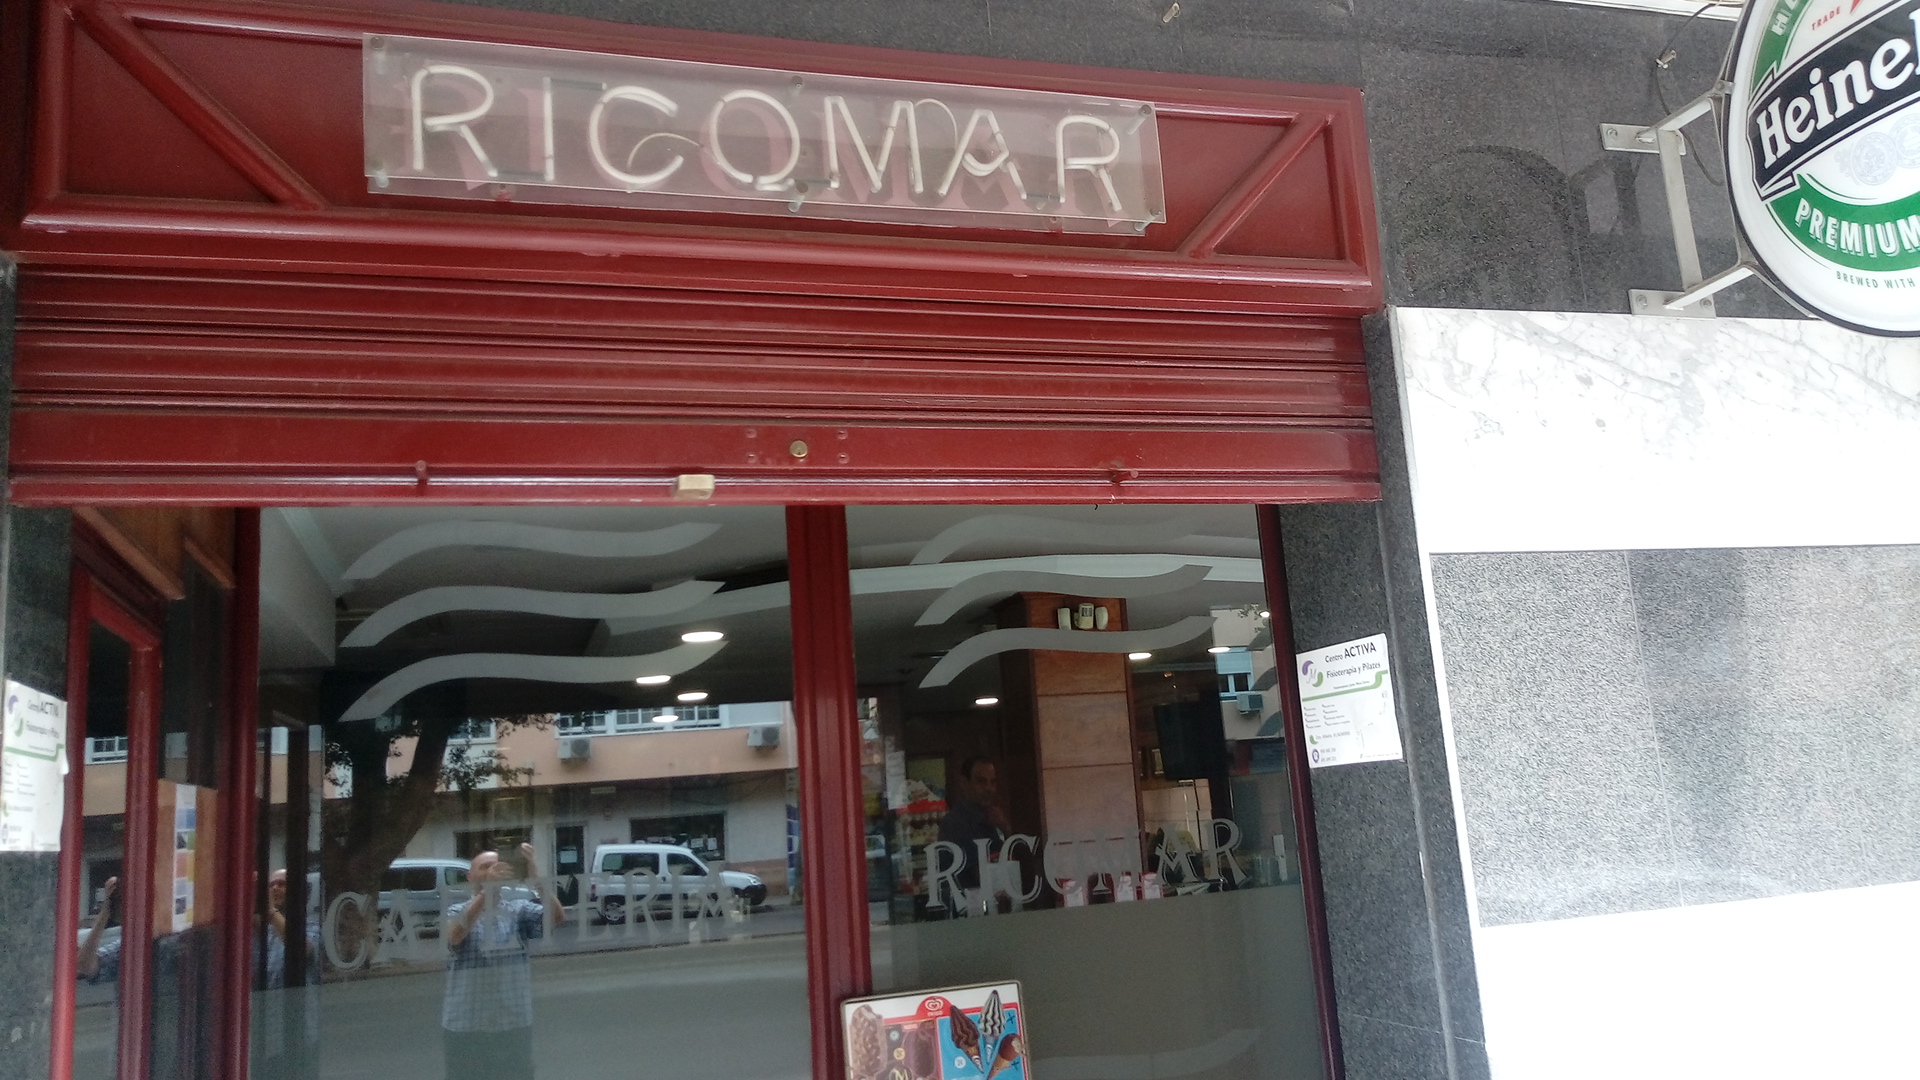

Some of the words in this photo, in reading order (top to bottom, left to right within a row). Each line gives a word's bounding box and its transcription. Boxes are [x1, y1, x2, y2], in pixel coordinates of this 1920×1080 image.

[1811, 6, 1841, 31] TRADE
[409, 64, 1124, 213] RICOMAR
[1794, 198, 1920, 258] PREMIUM
[1836, 271, 1879, 288] BREWED
[1884, 278, 1916, 289] WITH
[1325, 654, 1344, 663] Centro
[1344, 641, 1377, 659] ACTIVA
[1362, 662, 1381, 671] Pilates
